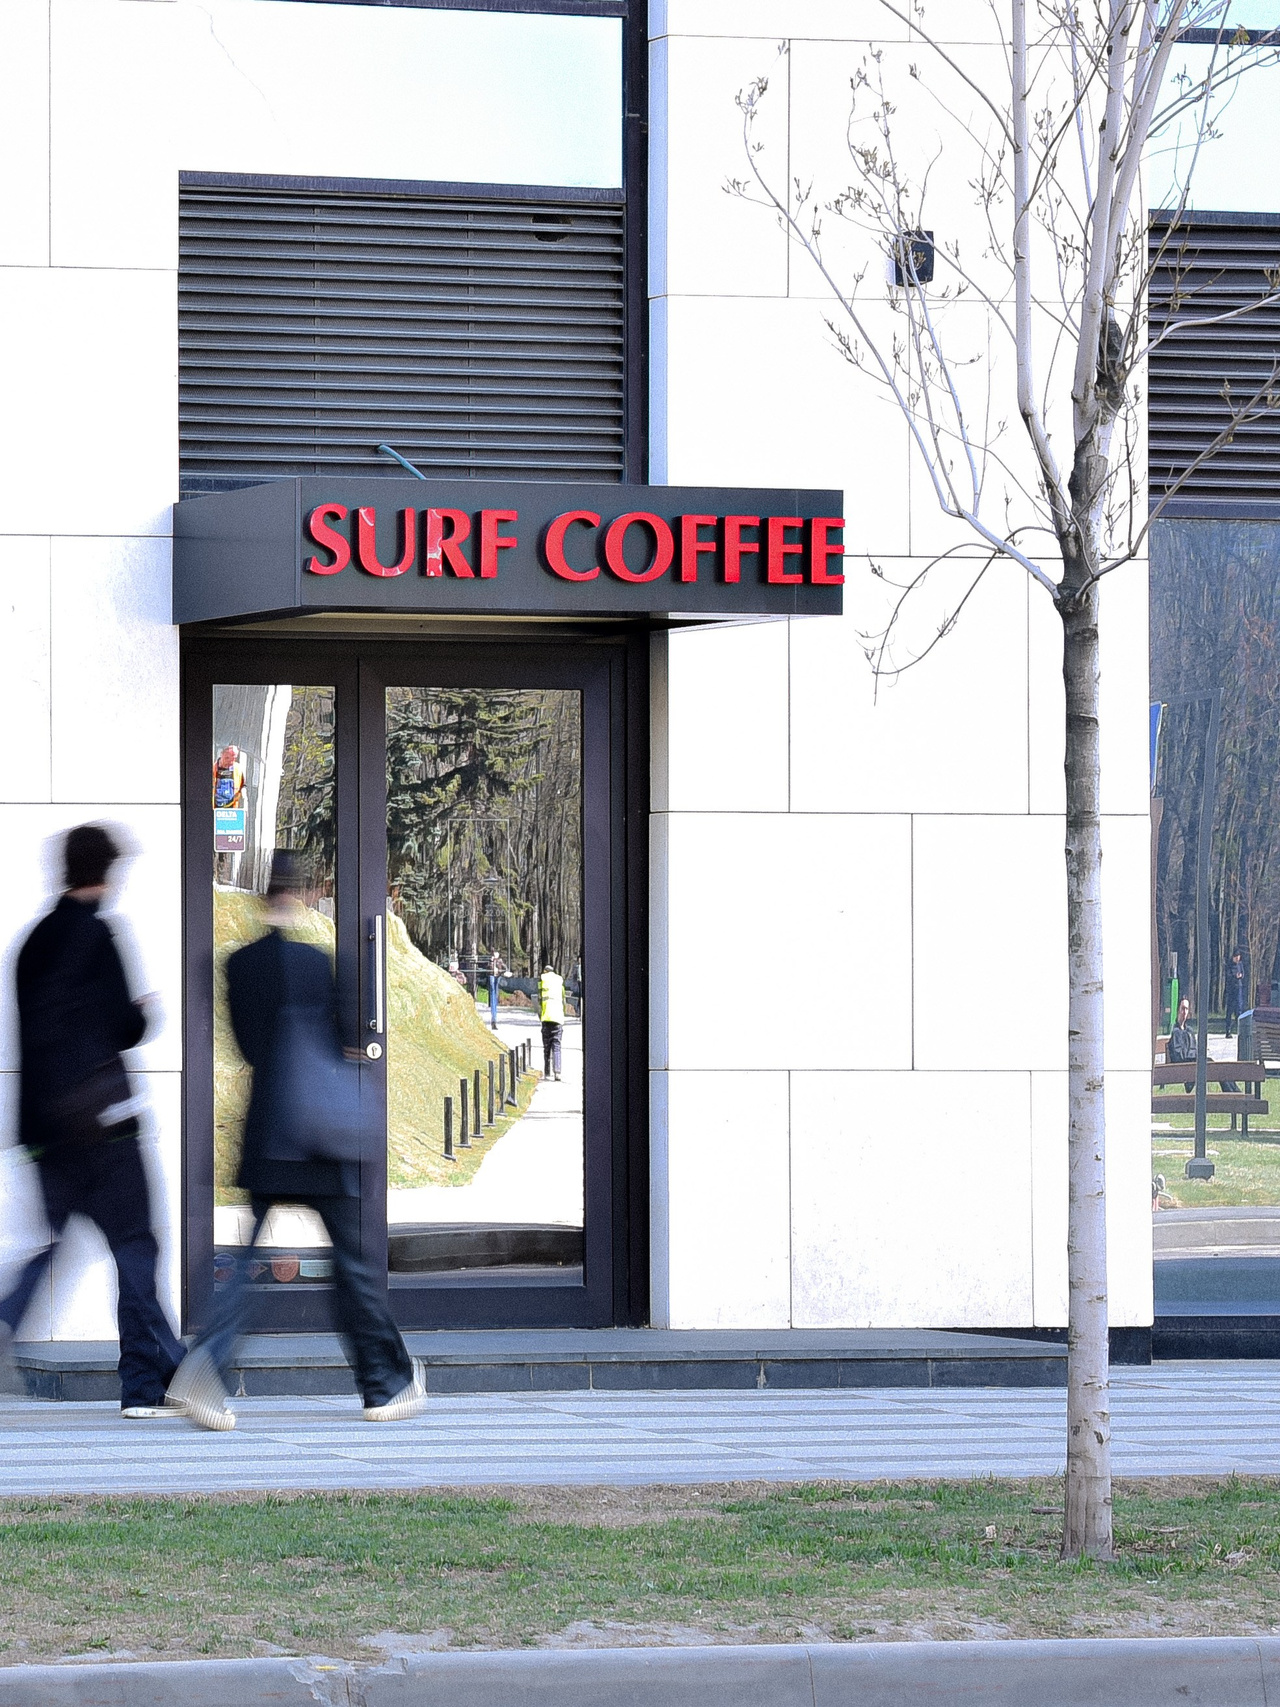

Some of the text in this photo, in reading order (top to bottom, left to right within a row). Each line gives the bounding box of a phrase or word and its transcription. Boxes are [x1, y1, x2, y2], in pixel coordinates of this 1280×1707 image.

[306, 502, 846, 585] SURF COFFEE
[228, 835, 242, 843] 24/7
